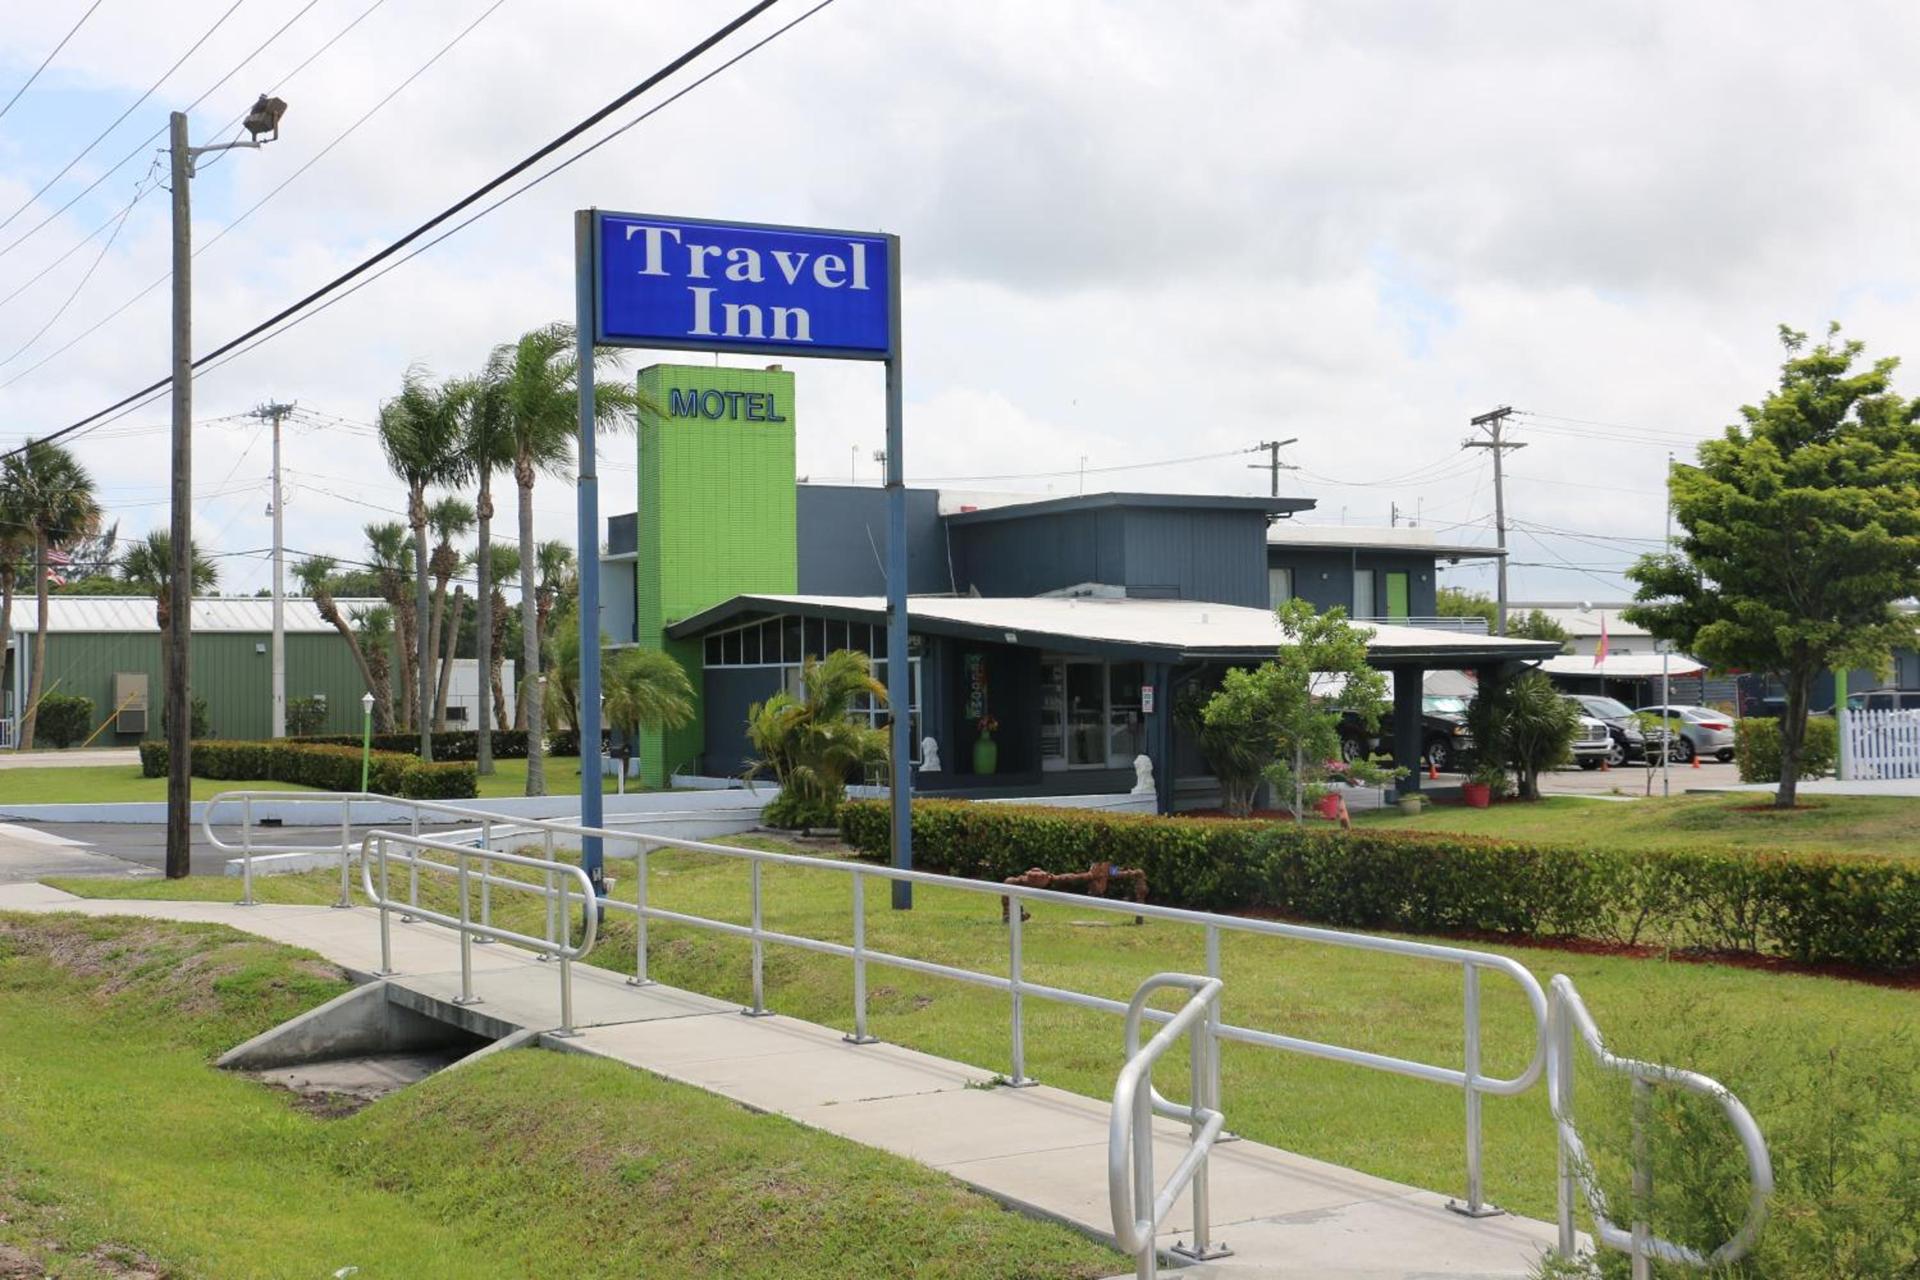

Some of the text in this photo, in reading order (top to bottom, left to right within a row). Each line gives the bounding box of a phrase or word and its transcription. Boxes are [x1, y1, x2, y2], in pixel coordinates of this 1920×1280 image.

[626, 225, 870, 289] Travel
[688, 287, 814, 341] Inn
[669, 388, 787, 422] MOTEL
